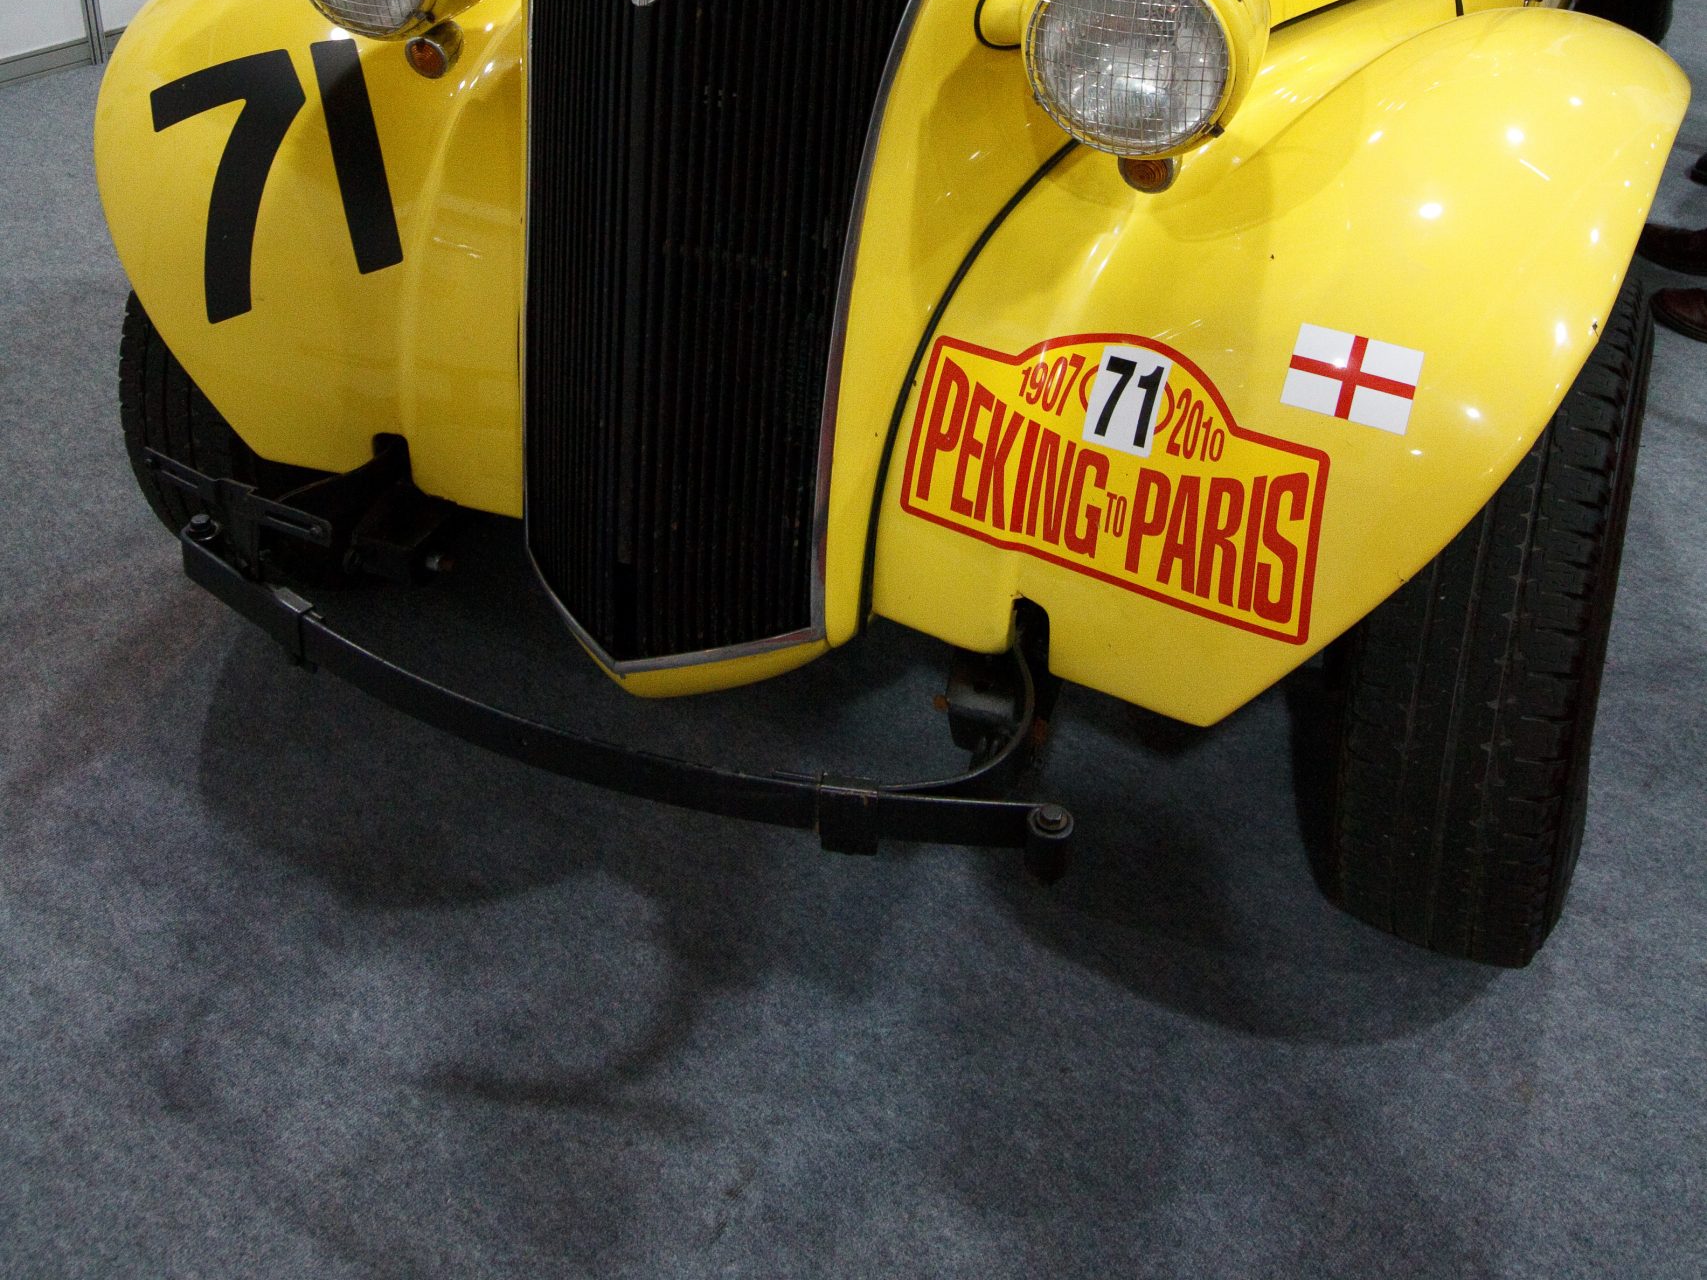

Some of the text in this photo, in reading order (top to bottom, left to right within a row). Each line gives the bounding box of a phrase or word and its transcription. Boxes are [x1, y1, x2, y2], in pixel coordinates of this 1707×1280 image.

[150, 38, 403, 324] 71
[916, 357, 1310, 624] PEKING TO PARIS
[1019, 354, 1225, 462] 1907 71 2010
